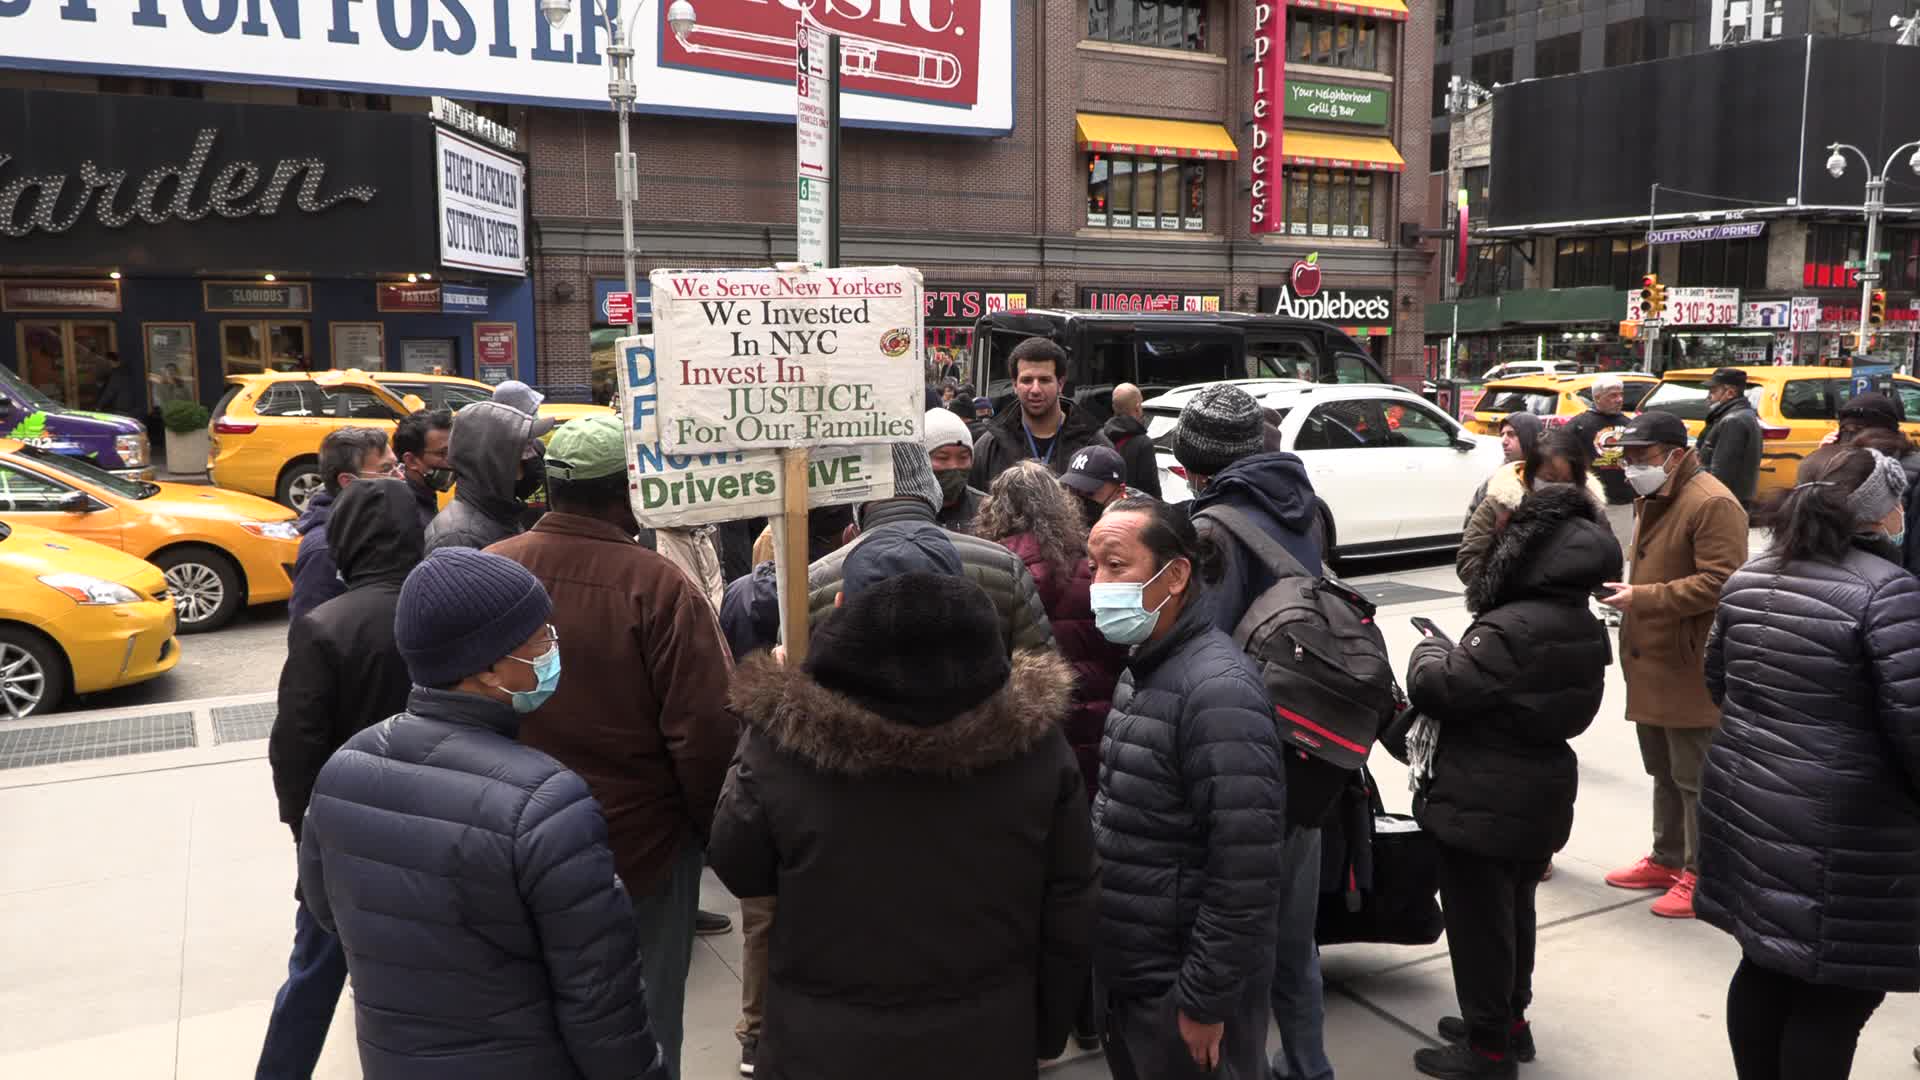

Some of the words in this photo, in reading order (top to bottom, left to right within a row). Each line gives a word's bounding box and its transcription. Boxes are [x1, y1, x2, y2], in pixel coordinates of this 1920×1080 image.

[800, 76, 807, 95] 3
[1292, 86, 1313, 101] Your
[1315, 88, 1372, 104] Neighborhood
[1307, 103, 1330, 114] Grill
[1339, 105, 1356, 116] Bar
[444, 149, 473, 197] HUGH
[474, 161, 518, 210] JACKMAN
[801, 180, 807, 198] 6
[446, 207, 485, 254] SUTTON
[486, 218, 520, 259] FOSTER
[672, 279, 709, 297] We
[716, 278, 770, 297] Serve
[777, 278, 821, 296] New
[826, 276, 902, 295] Yorkers
[700, 300, 751, 326] We
[761, 299, 870, 325] Invested
[1275, 285, 1389, 320] Applebee's
[731, 332, 759, 356] In
[770, 330, 838, 355] NYC
[680, 359, 766, 386] Invest
[776, 358, 804, 383] In
[1857, 380, 1867, 394] P
[724, 384, 875, 421] JUSTICE
[676, 418, 726, 445] For
[736, 416, 795, 442] Our
[803, 413, 914, 440] Families
[1072, 454, 1088, 470] NY
[641, 472, 776, 509] Drivers
